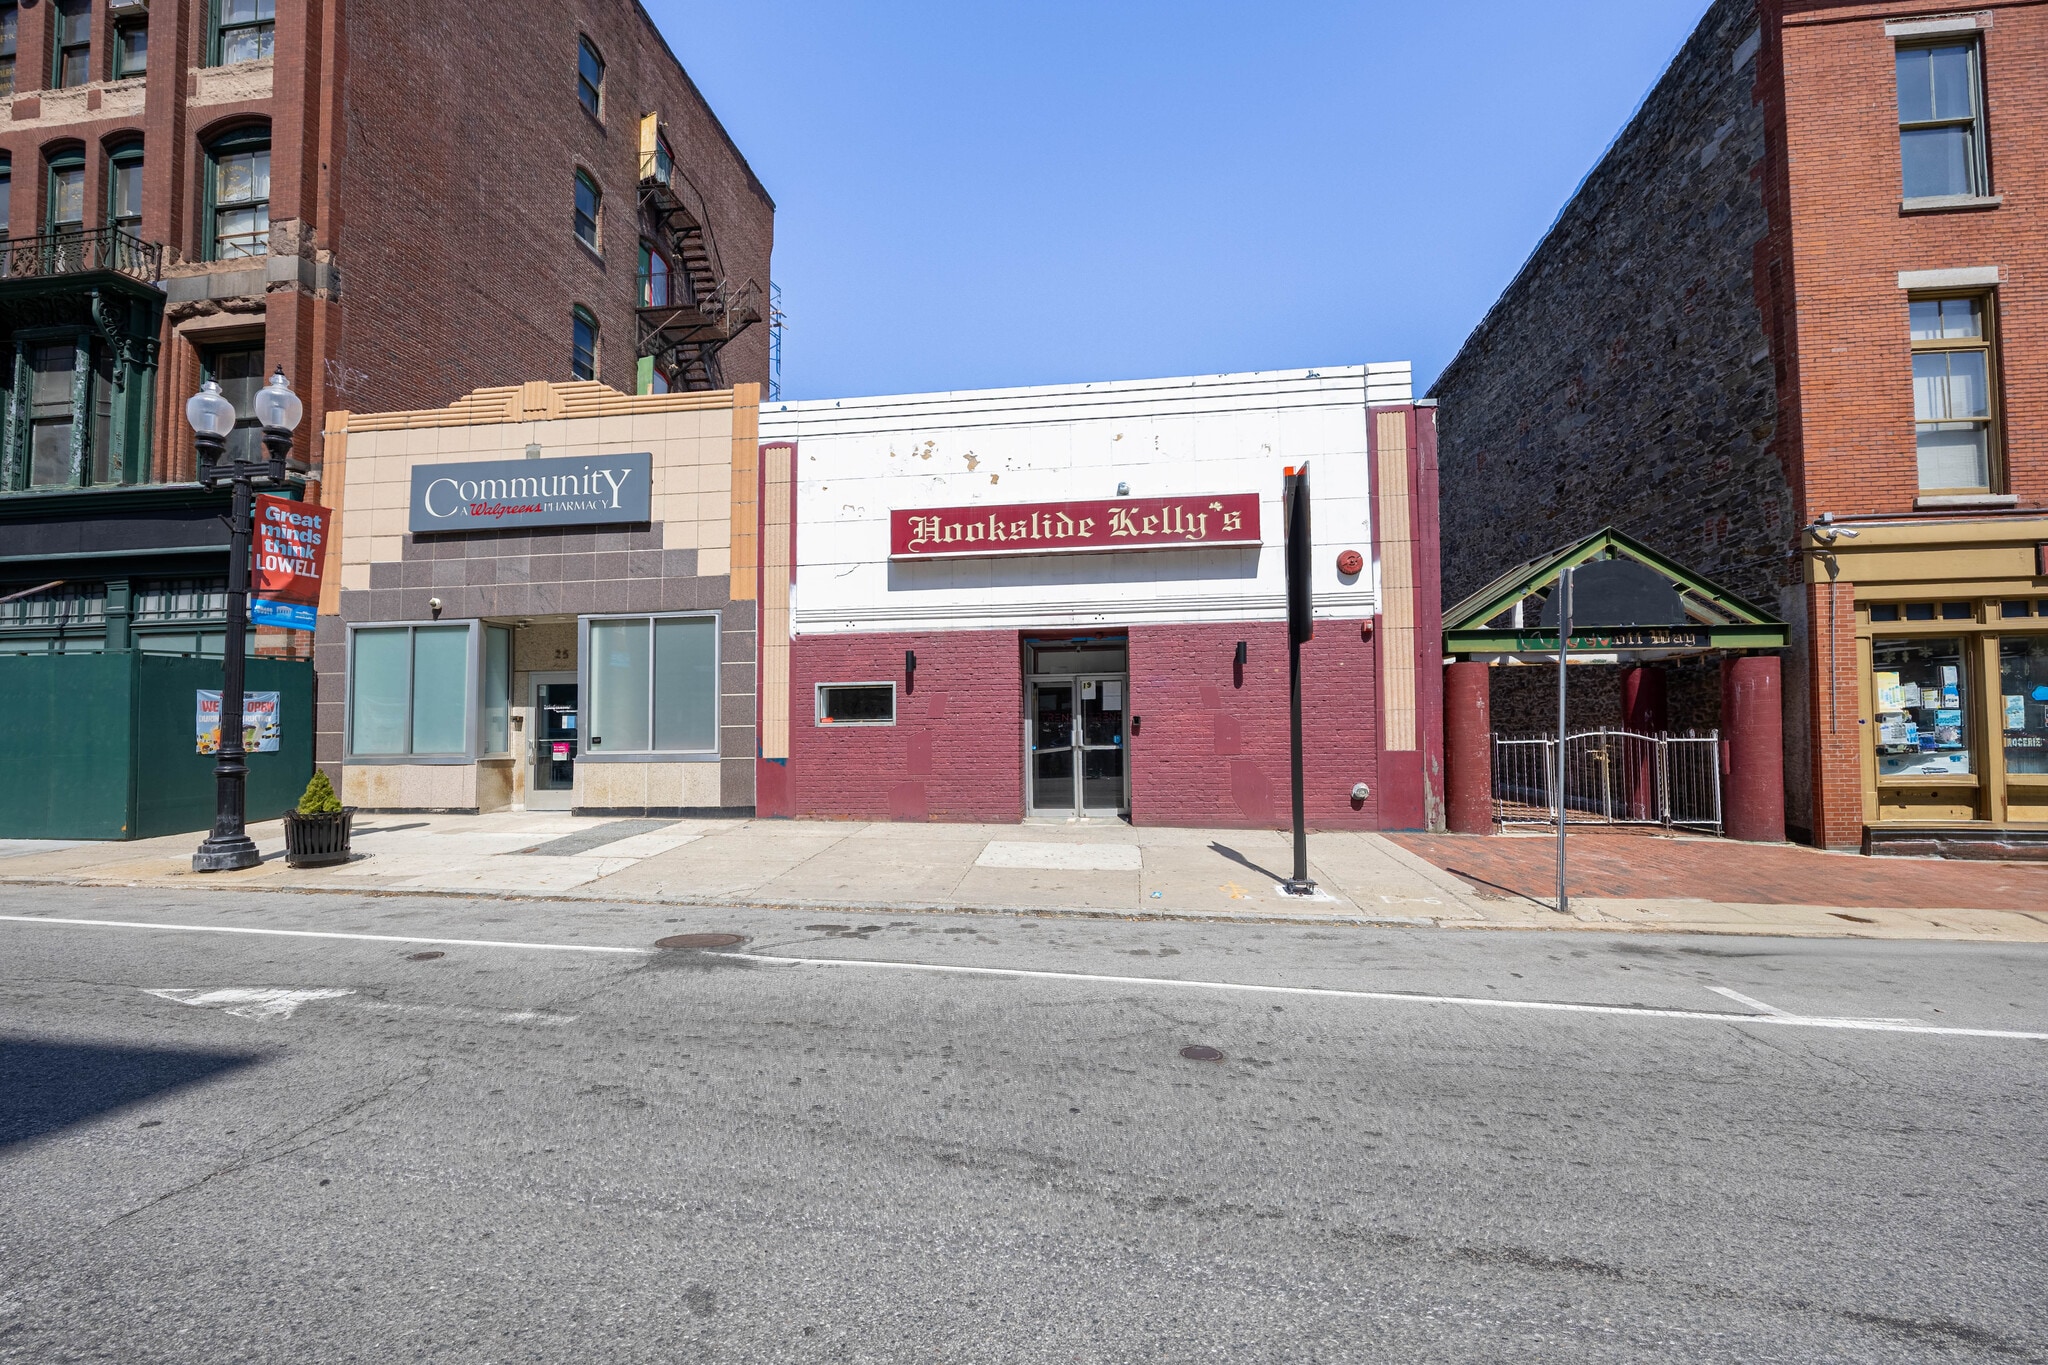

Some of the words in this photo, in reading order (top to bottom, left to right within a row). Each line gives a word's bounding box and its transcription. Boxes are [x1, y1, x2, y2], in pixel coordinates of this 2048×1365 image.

[265, 505, 322, 529] Great
[459, 506, 468, 517] A
[470, 502, 542, 519] Walgreens
[543, 499, 609, 513] PHARMACY
[260, 523, 322, 545] minds
[908, 511, 1096, 553] Hookslide
[264, 538, 316, 560] think
[256, 553, 320, 578] LOWELL
[1649, 629, 1695, 647] Way
[554, 650, 569, 659] 25
[202, 701, 219, 712] WE
[247, 702, 275, 713] OPEN
